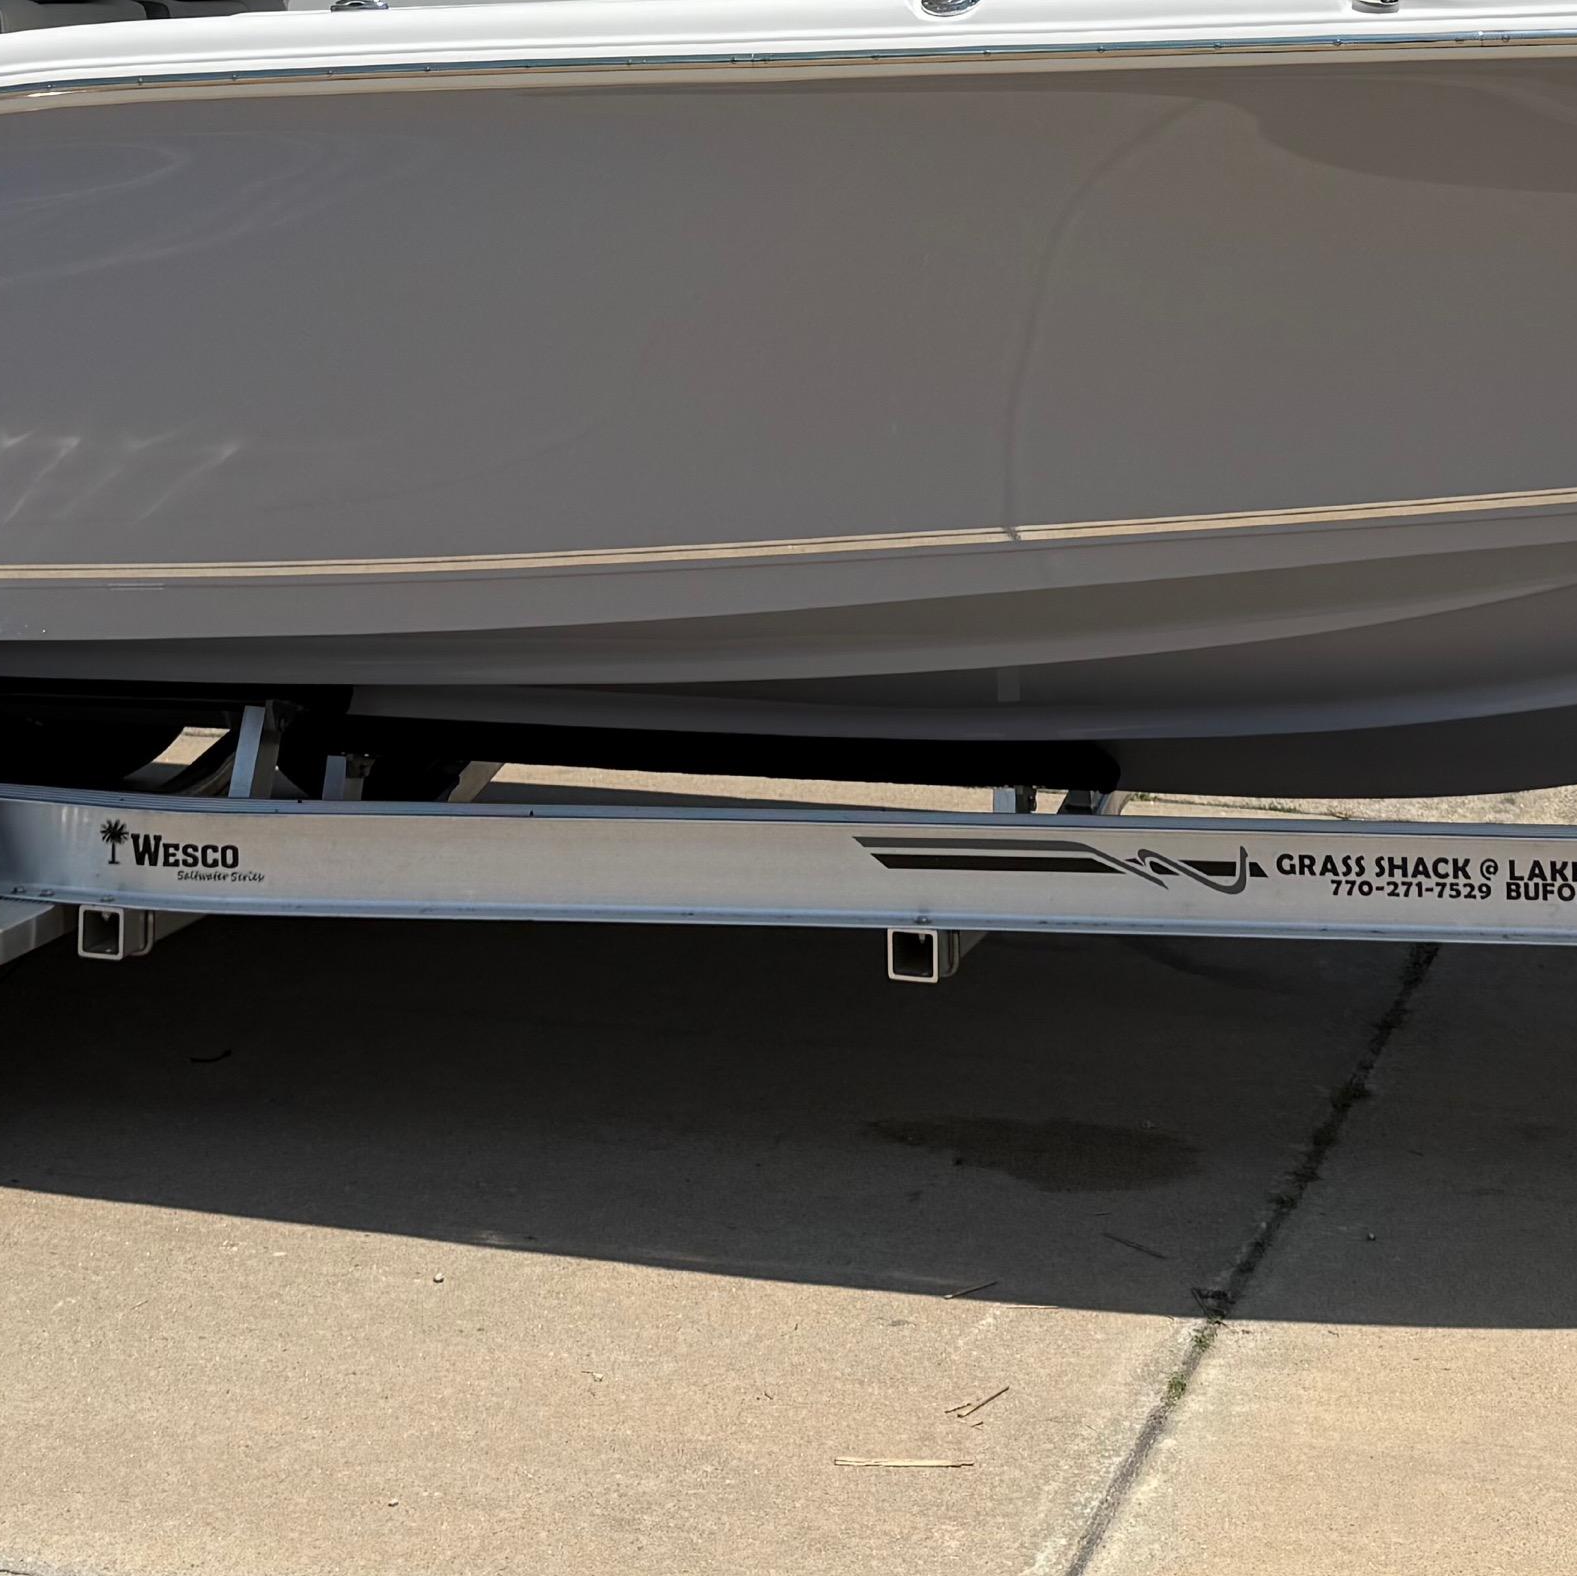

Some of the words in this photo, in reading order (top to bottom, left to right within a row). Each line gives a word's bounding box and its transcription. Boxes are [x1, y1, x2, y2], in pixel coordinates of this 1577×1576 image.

[176, 870, 228, 882] Saltwater
[1275, 853, 1366, 877] GRASS
[1374, 855, 1472, 880] SHACK
[1479, 858, 1500, 882] @
[1330, 878, 1493, 901] 770-271-7529
